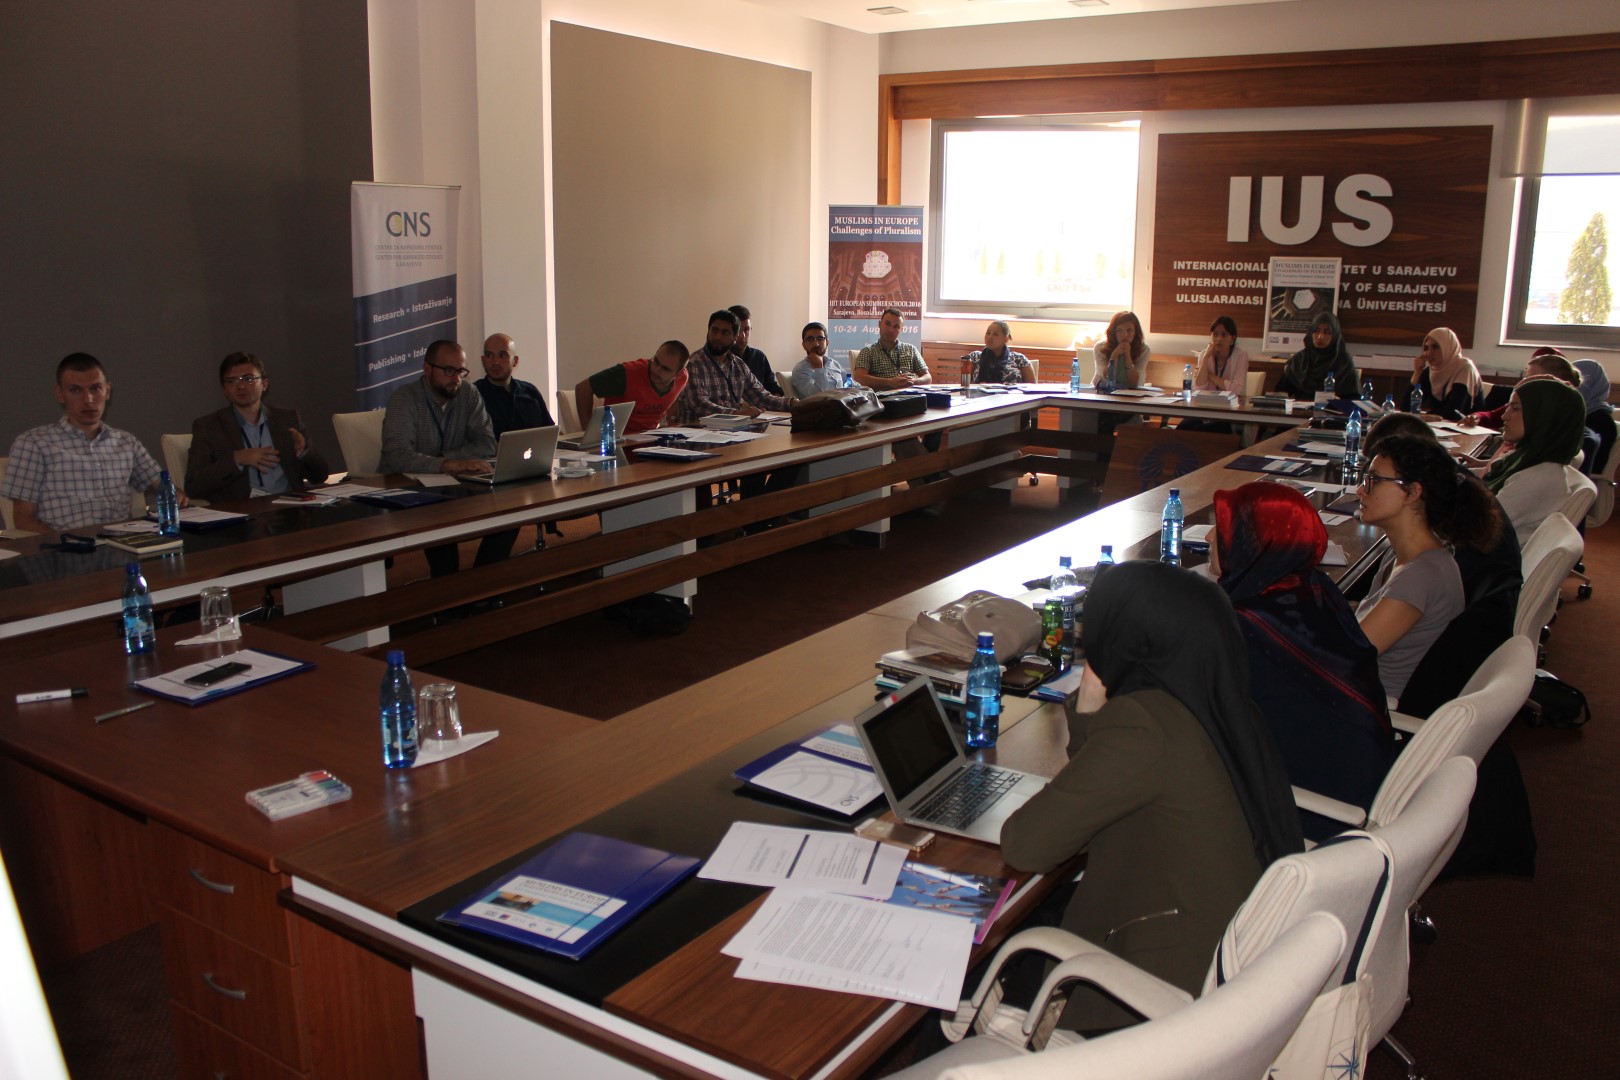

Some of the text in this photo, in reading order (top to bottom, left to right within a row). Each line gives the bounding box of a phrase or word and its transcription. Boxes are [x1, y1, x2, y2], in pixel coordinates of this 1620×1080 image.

[1227, 173, 1394, 247] IUS
[386, 211, 431, 238] CNS
[834, 216, 919, 226] MUSLIMS IN EUROPE
[831, 226, 921, 236] Challenges of Pluralism
[1173, 260, 1270, 272] INTERNACIONAL
[1372, 265, 1382, 275] U
[1386, 265, 1457, 277] SARAJEVU
[1177, 277, 1268, 289] INTERNATIONAL
[1355, 283, 1373, 293] OF
[1377, 283, 1447, 295] SARAJEVO
[888, 300, 907, 308] SCHOOL
[1176, 293, 1264, 306] ULUSLARARASI
[373, 297, 453, 323] Research Istraživanje
[834, 325, 857, 333] 10-24
[862, 325, 880, 335] Aug
[368, 353, 406, 372] Publishing
